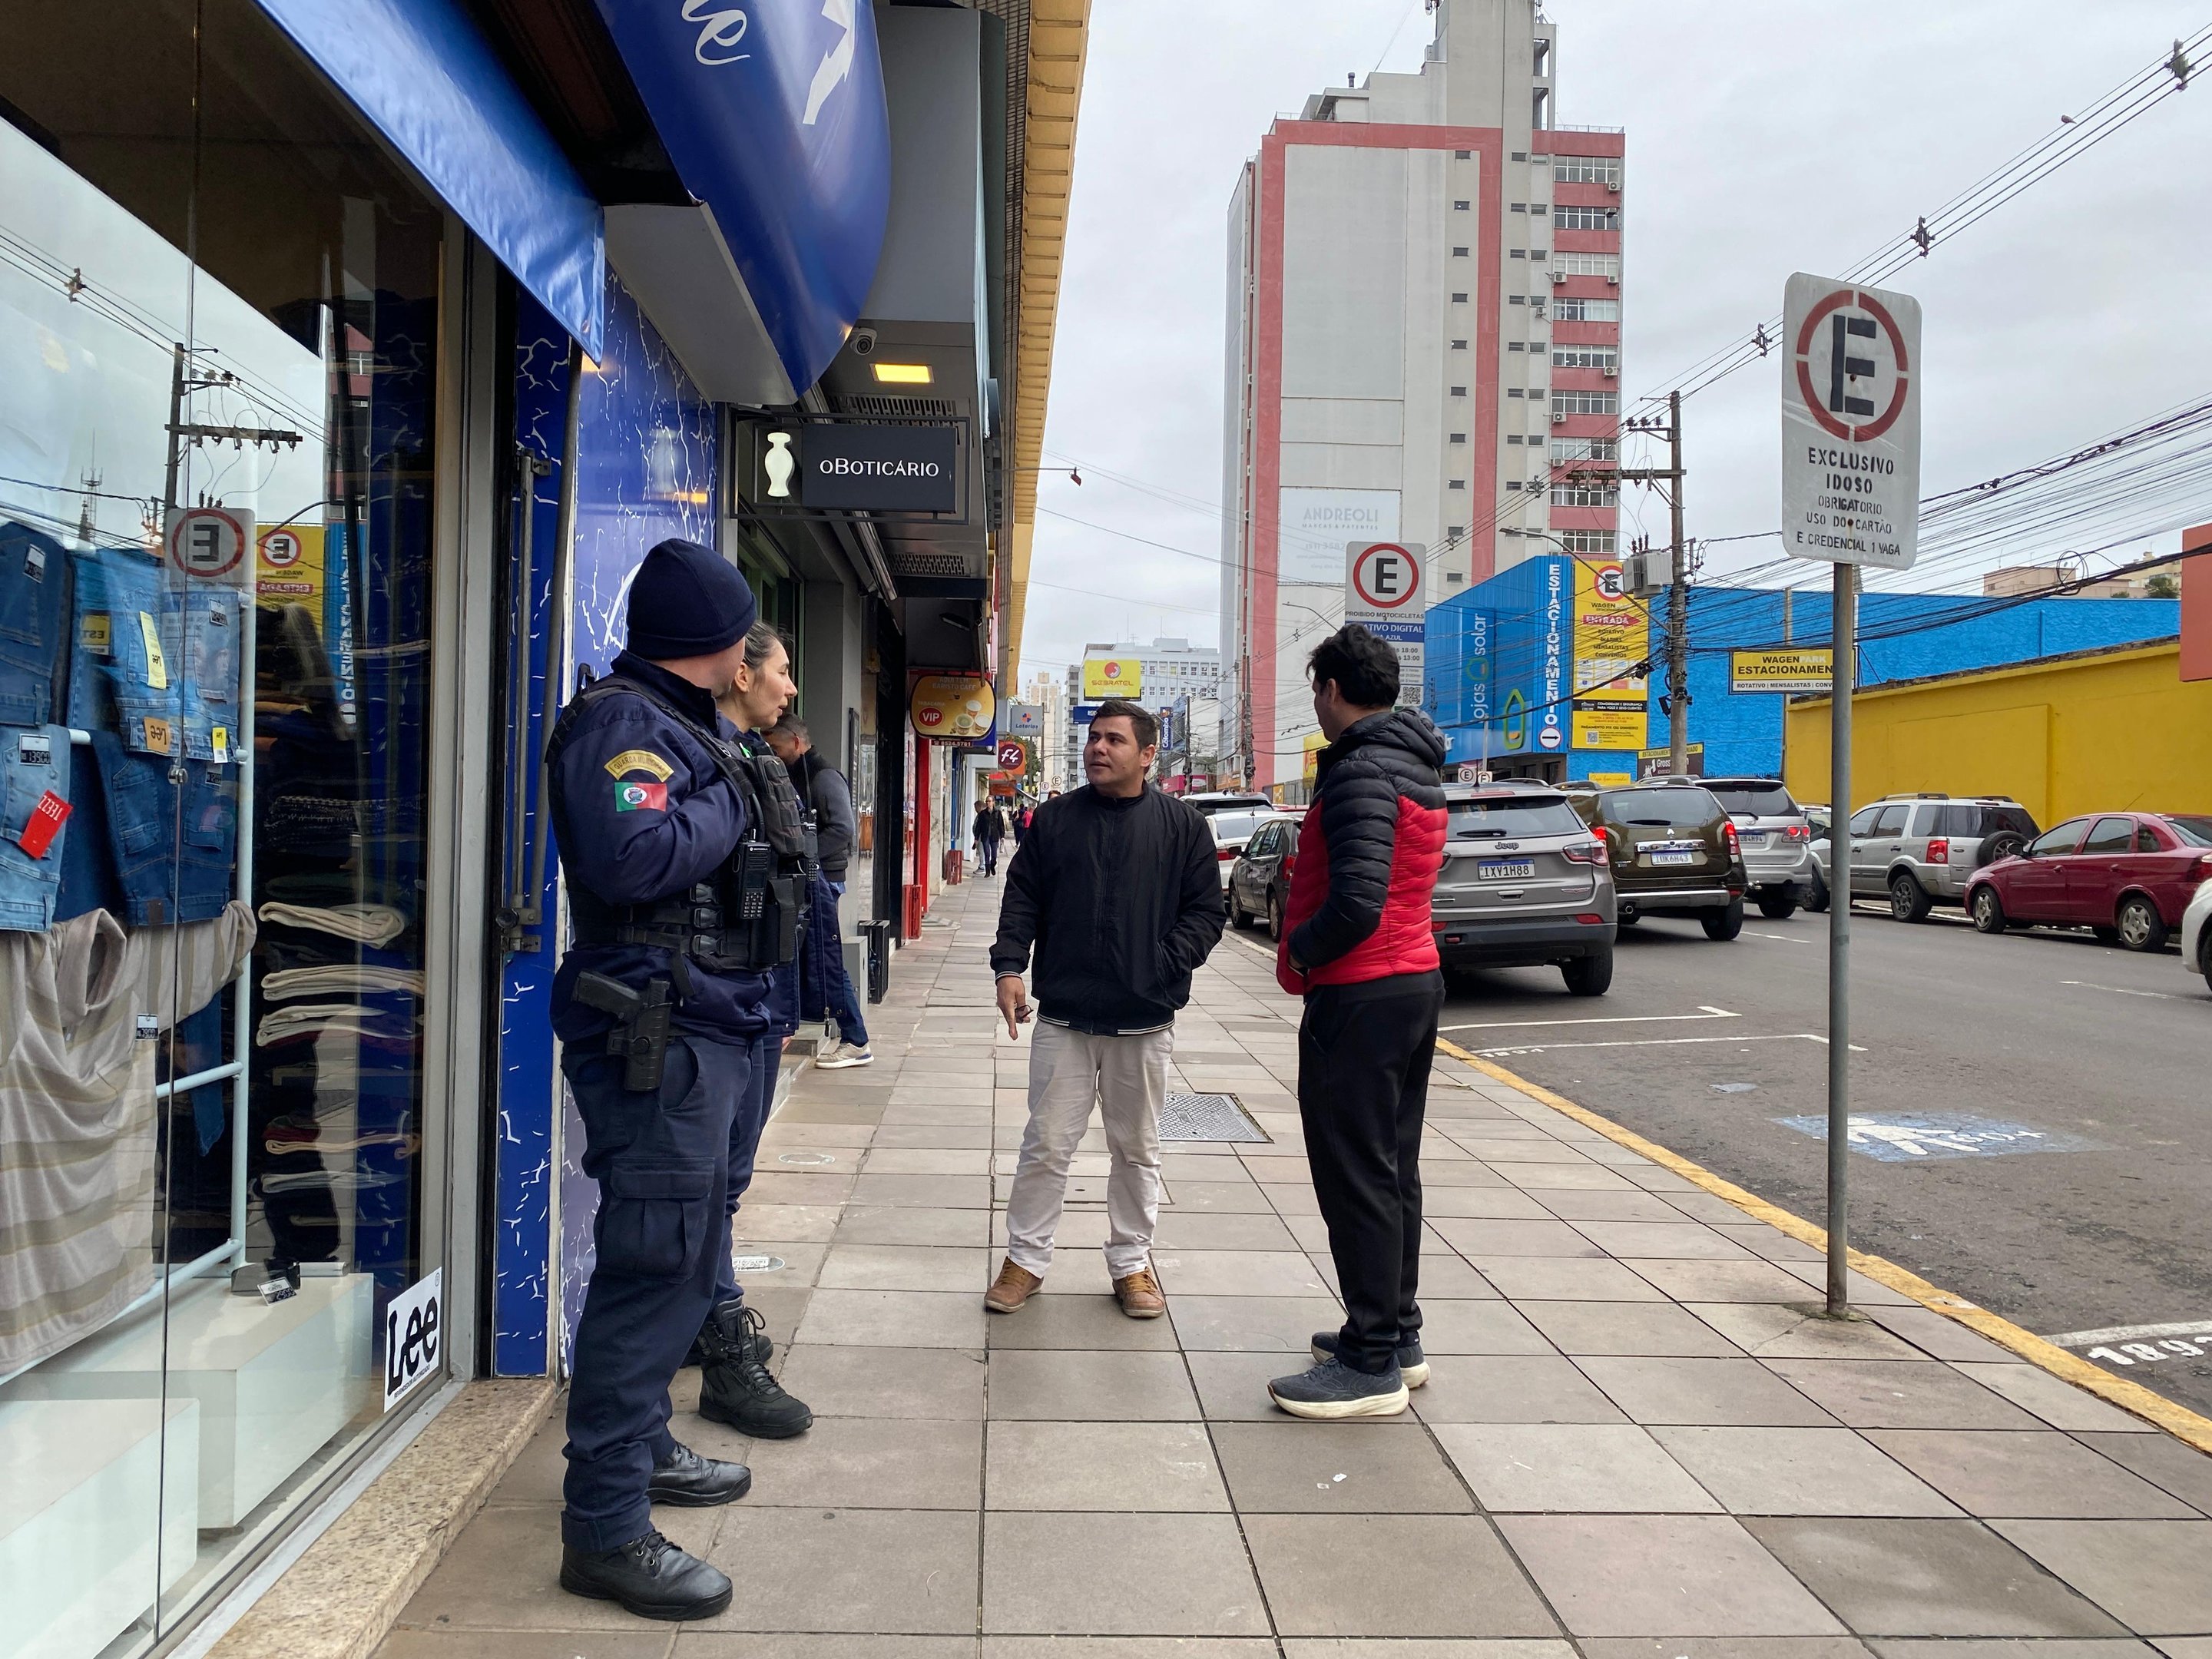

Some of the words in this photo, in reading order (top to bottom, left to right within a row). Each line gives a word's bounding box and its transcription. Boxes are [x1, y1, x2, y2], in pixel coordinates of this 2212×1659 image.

[1830, 314, 1876, 417] E
[1808, 447, 1894, 475] EXCLUSIVO
[1826, 473, 1873, 494] IDOSO
[1303, 508, 1379, 522] ANDREOLI
[1818, 495, 1882, 515] OBRIGATORIO
[1806, 512, 1826, 525] USO
[1833, 515, 1846, 528] DO
[1856, 518, 1892, 534] CARTÃO
[1797, 531, 1803, 543] E
[1808, 533, 1866, 551] CREDENCIAL
[1871, 542, 1876, 553] 1
[1879, 542, 1901, 556] VAGA
[1375, 558, 1398, 594] E
[1390, 624, 1423, 633] DIGITAL
[1586, 615, 1629, 624] ENTRADA
[1471, 613, 1486, 656] solar
[1544, 565, 1560, 725] ESTACIONAMENTO
[1738, 665, 1833, 674] ESTACIONAMEN
[922, 712, 939, 723] VIP
[150, 725, 167, 746] Lee
[614, 755, 637, 770] GUARDA
[1495, 842, 1519, 850] Jeep
[1484, 865, 1530, 877] IXY1H88
[387, 1296, 438, 1396] Lee
